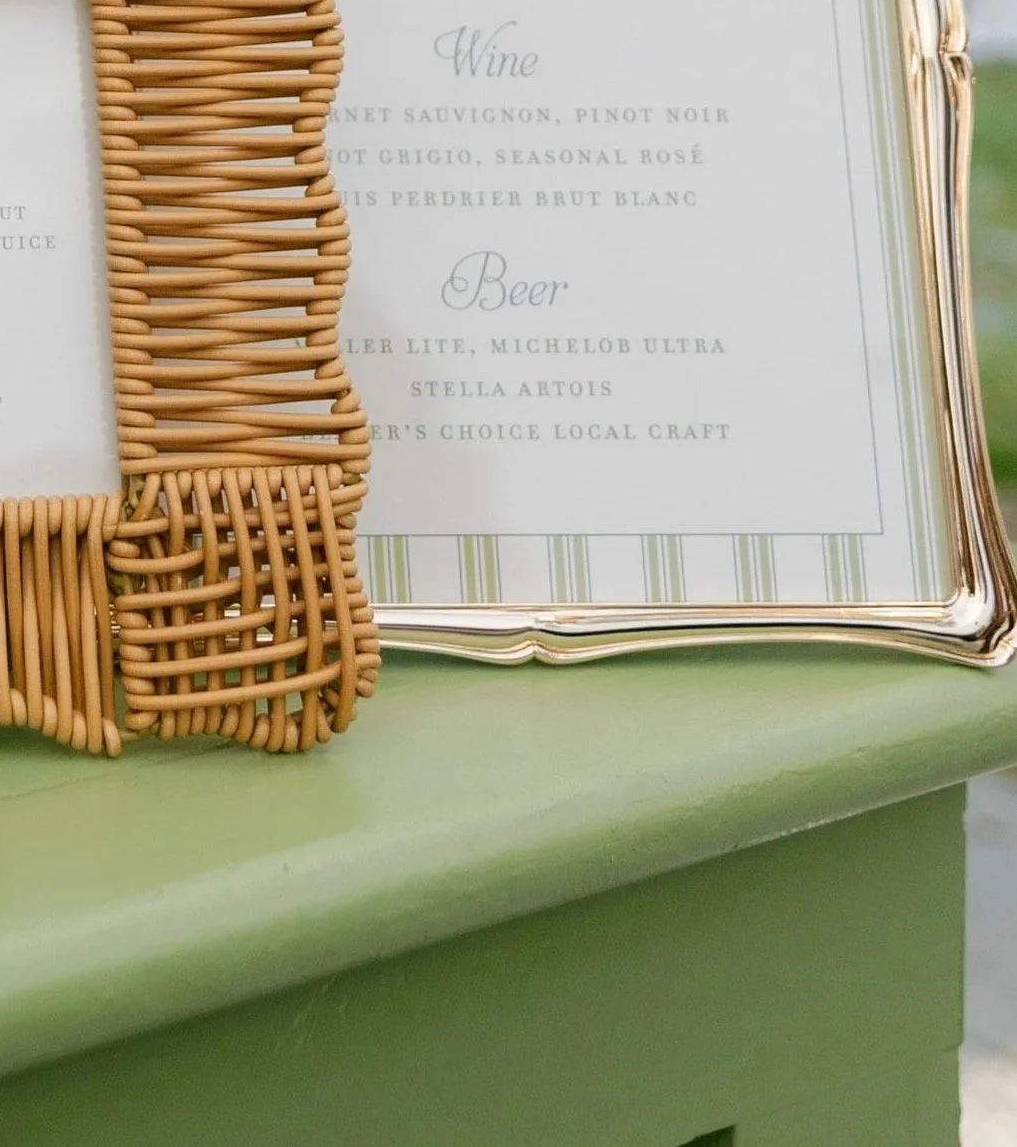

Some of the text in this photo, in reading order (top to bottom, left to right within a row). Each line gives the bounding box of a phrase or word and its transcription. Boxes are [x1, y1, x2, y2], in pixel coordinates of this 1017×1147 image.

[434, 21, 539, 78] Wine
[404, 107, 560, 125] SAUVIGNON,
[576, 108, 652, 123] PINOT
[666, 107, 728, 123] NOIR
[379, 149, 481, 167] GRIGIO,
[495, 149, 627, 165] SEASONAL
[640, 143, 703, 165] ROSÉ
[392, 191, 522, 207] PERDRIER
[536, 191, 601, 206] BRUT
[615, 191, 696, 207] BLANC
[441, 251, 569, 311] Beer
[407, 338, 475, 357] LITE,
[491, 338, 630, 354] MICHELOB
[643, 338, 725, 354] ULTRA
[411, 381, 612, 397] STELLA ARTOIS
[440, 424, 540, 441] CHOICE
[554, 424, 636, 440] LOCAL
[649, 424, 729, 440] CRAFT
